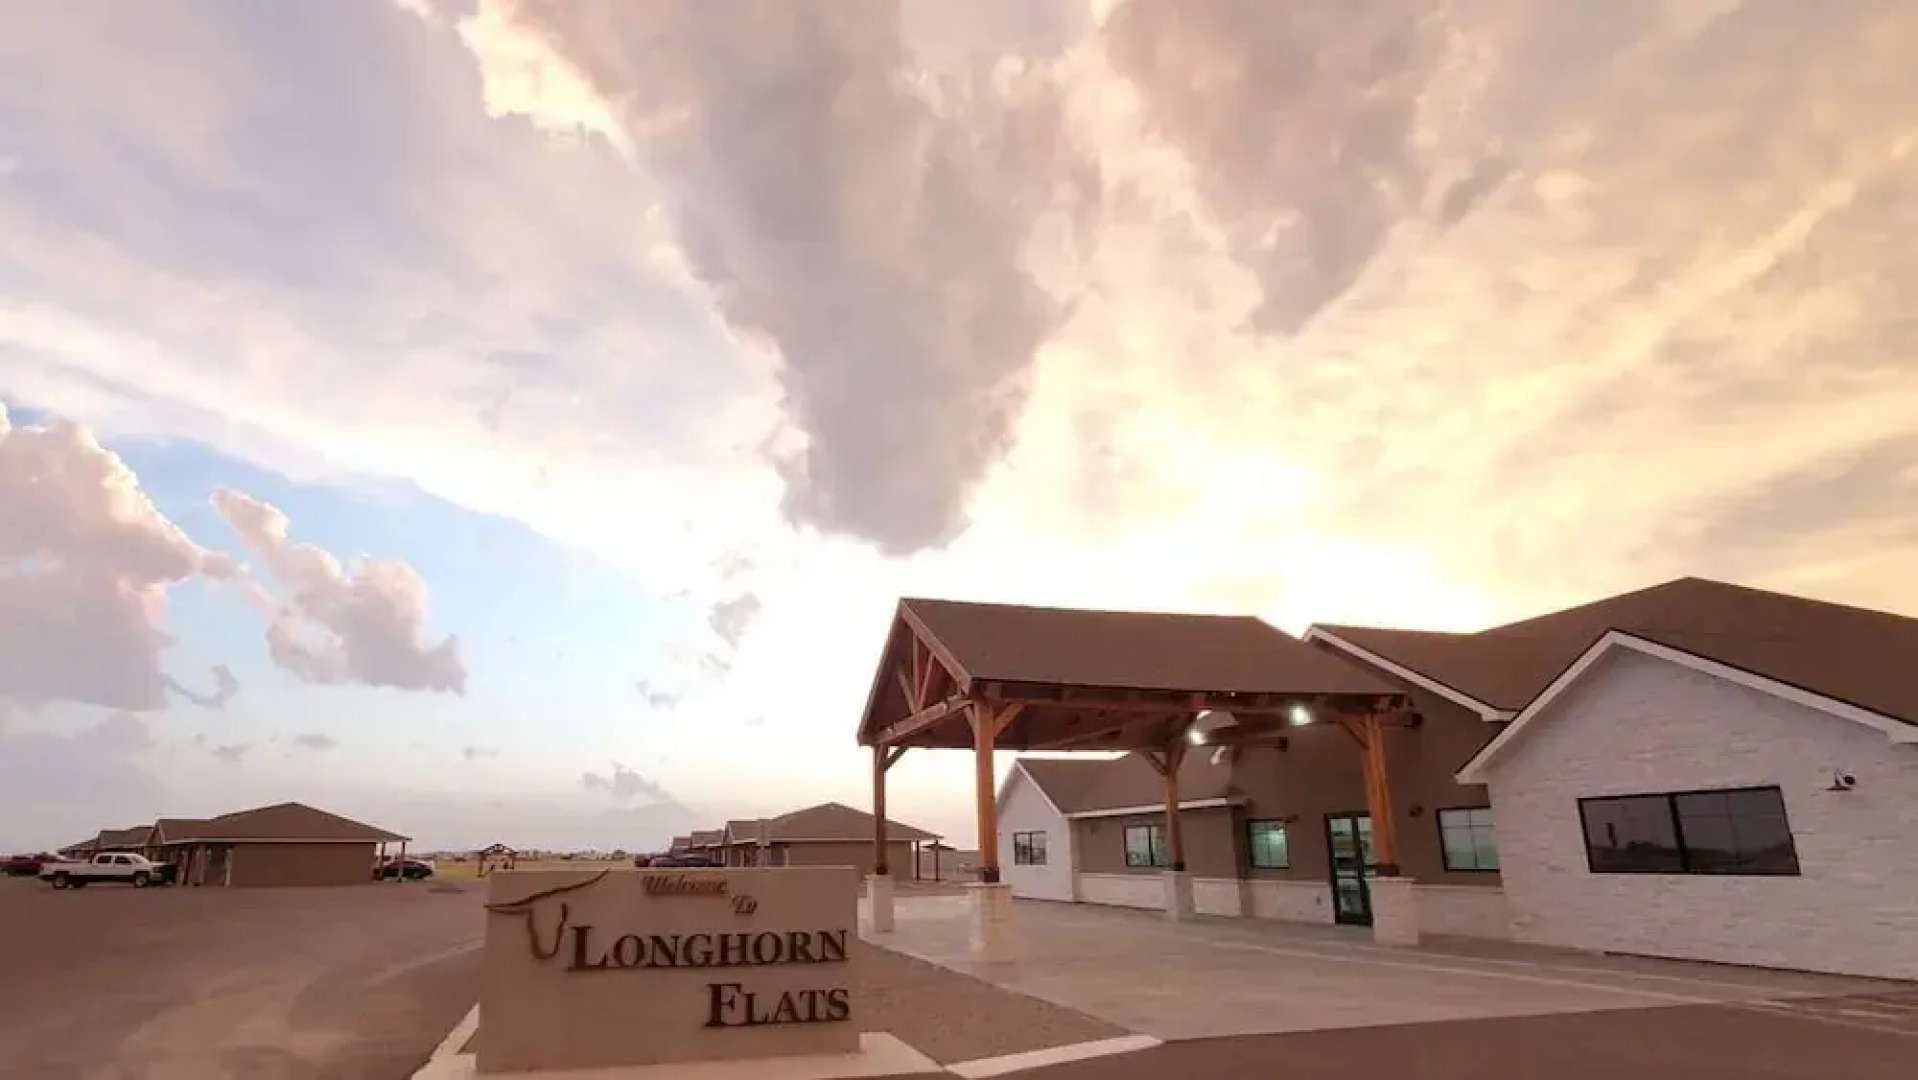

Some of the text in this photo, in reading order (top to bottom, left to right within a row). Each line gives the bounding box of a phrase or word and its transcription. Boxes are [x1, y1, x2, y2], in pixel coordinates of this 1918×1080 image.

[642, 876, 729, 896] Welcome
[730, 896, 759, 915] To
[567, 926, 849, 972] LONGHORN
[704, 982, 852, 1029] FLATS
